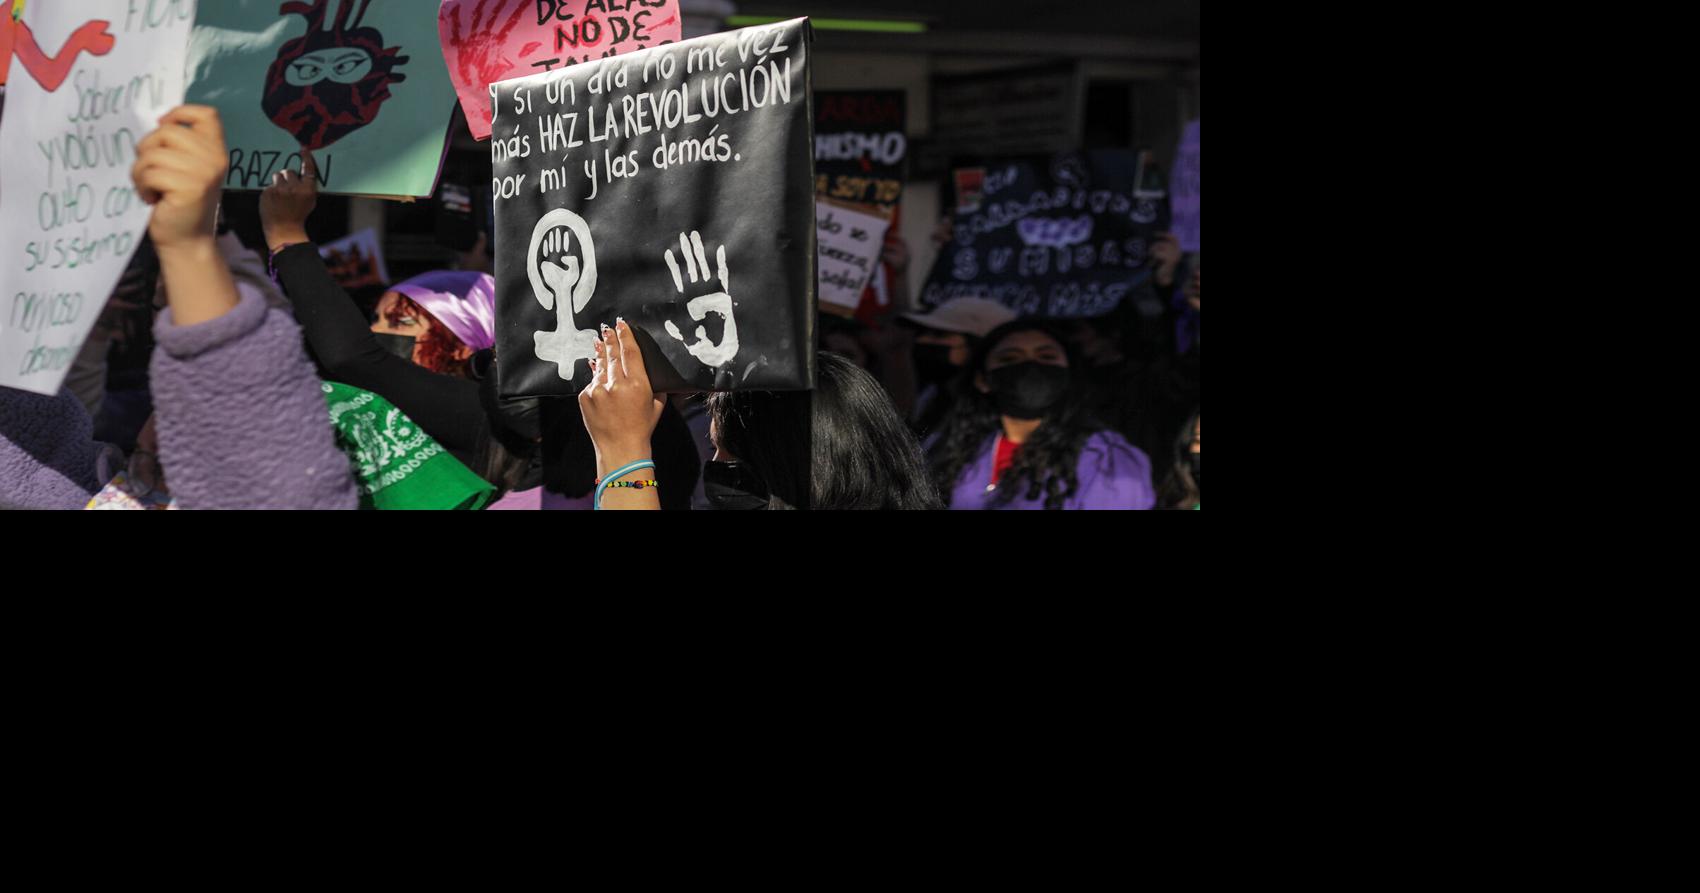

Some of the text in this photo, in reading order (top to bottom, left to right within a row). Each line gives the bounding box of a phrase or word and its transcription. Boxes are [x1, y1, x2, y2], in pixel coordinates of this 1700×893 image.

[537, 0, 574, 25] DE
[557, 11, 651, 51] NO DE
[545, 77, 576, 105] un
[642, 52, 676, 83] no
[687, 43, 729, 74] me
[736, 27, 789, 63] vez
[492, 124, 531, 164] más
[539, 112, 584, 153] HAZ
[588, 102, 619, 143] LA
[621, 55, 791, 139] REVOLUCIÓN
[493, 174, 526, 201] por
[540, 154, 567, 194] mí
[584, 159, 598, 200] y
[605, 149, 640, 184] las
[652, 124, 741, 171] demás.
